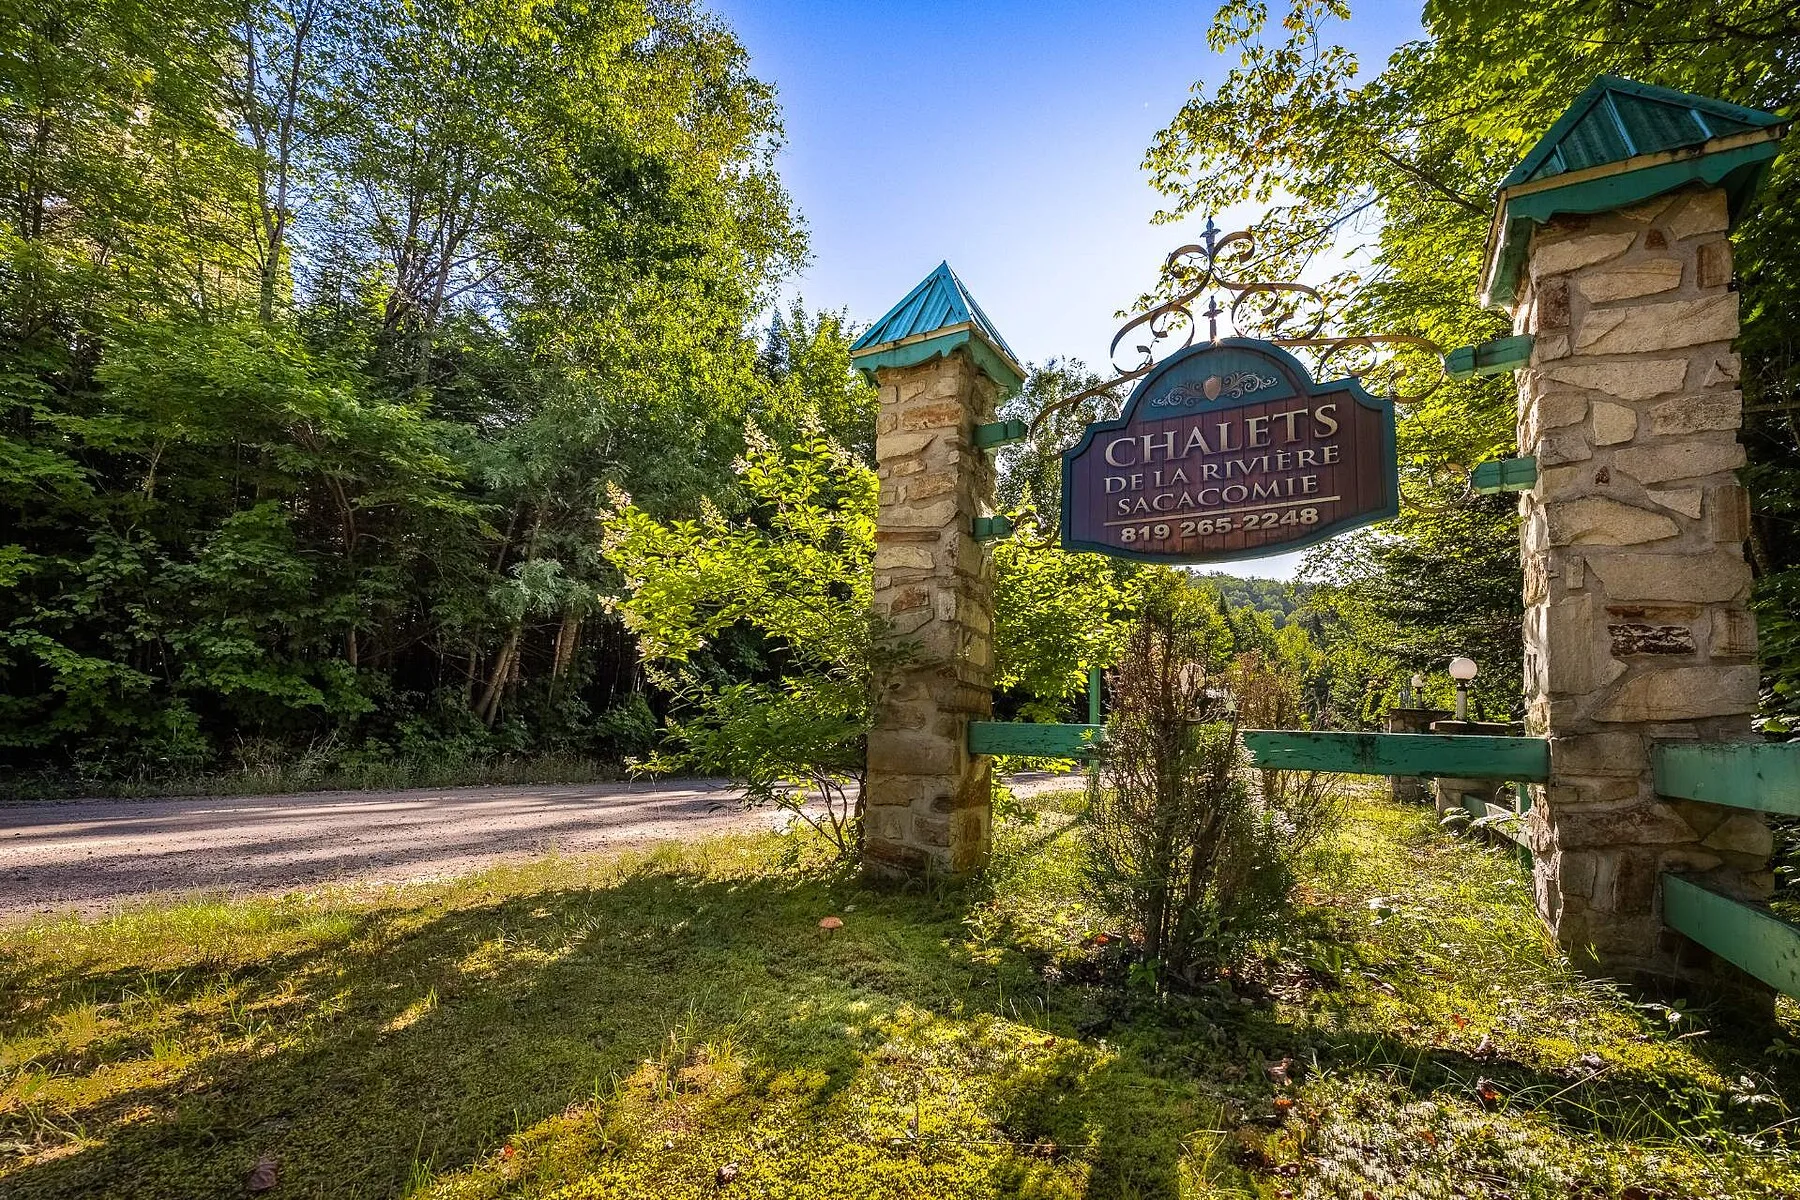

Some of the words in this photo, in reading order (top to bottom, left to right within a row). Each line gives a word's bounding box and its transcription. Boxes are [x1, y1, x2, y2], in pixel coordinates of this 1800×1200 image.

[1104, 403, 1338, 468] CHALETS
[1104, 473, 1144, 495] DE
[1154, 467, 1190, 488] LA
[1200, 444, 1340, 482] RIVIÈRE
[1117, 474, 1319, 516] SACACOMIE
[1120, 523, 1171, 544] 819
[1179, 507, 1320, 539] 265-2248
